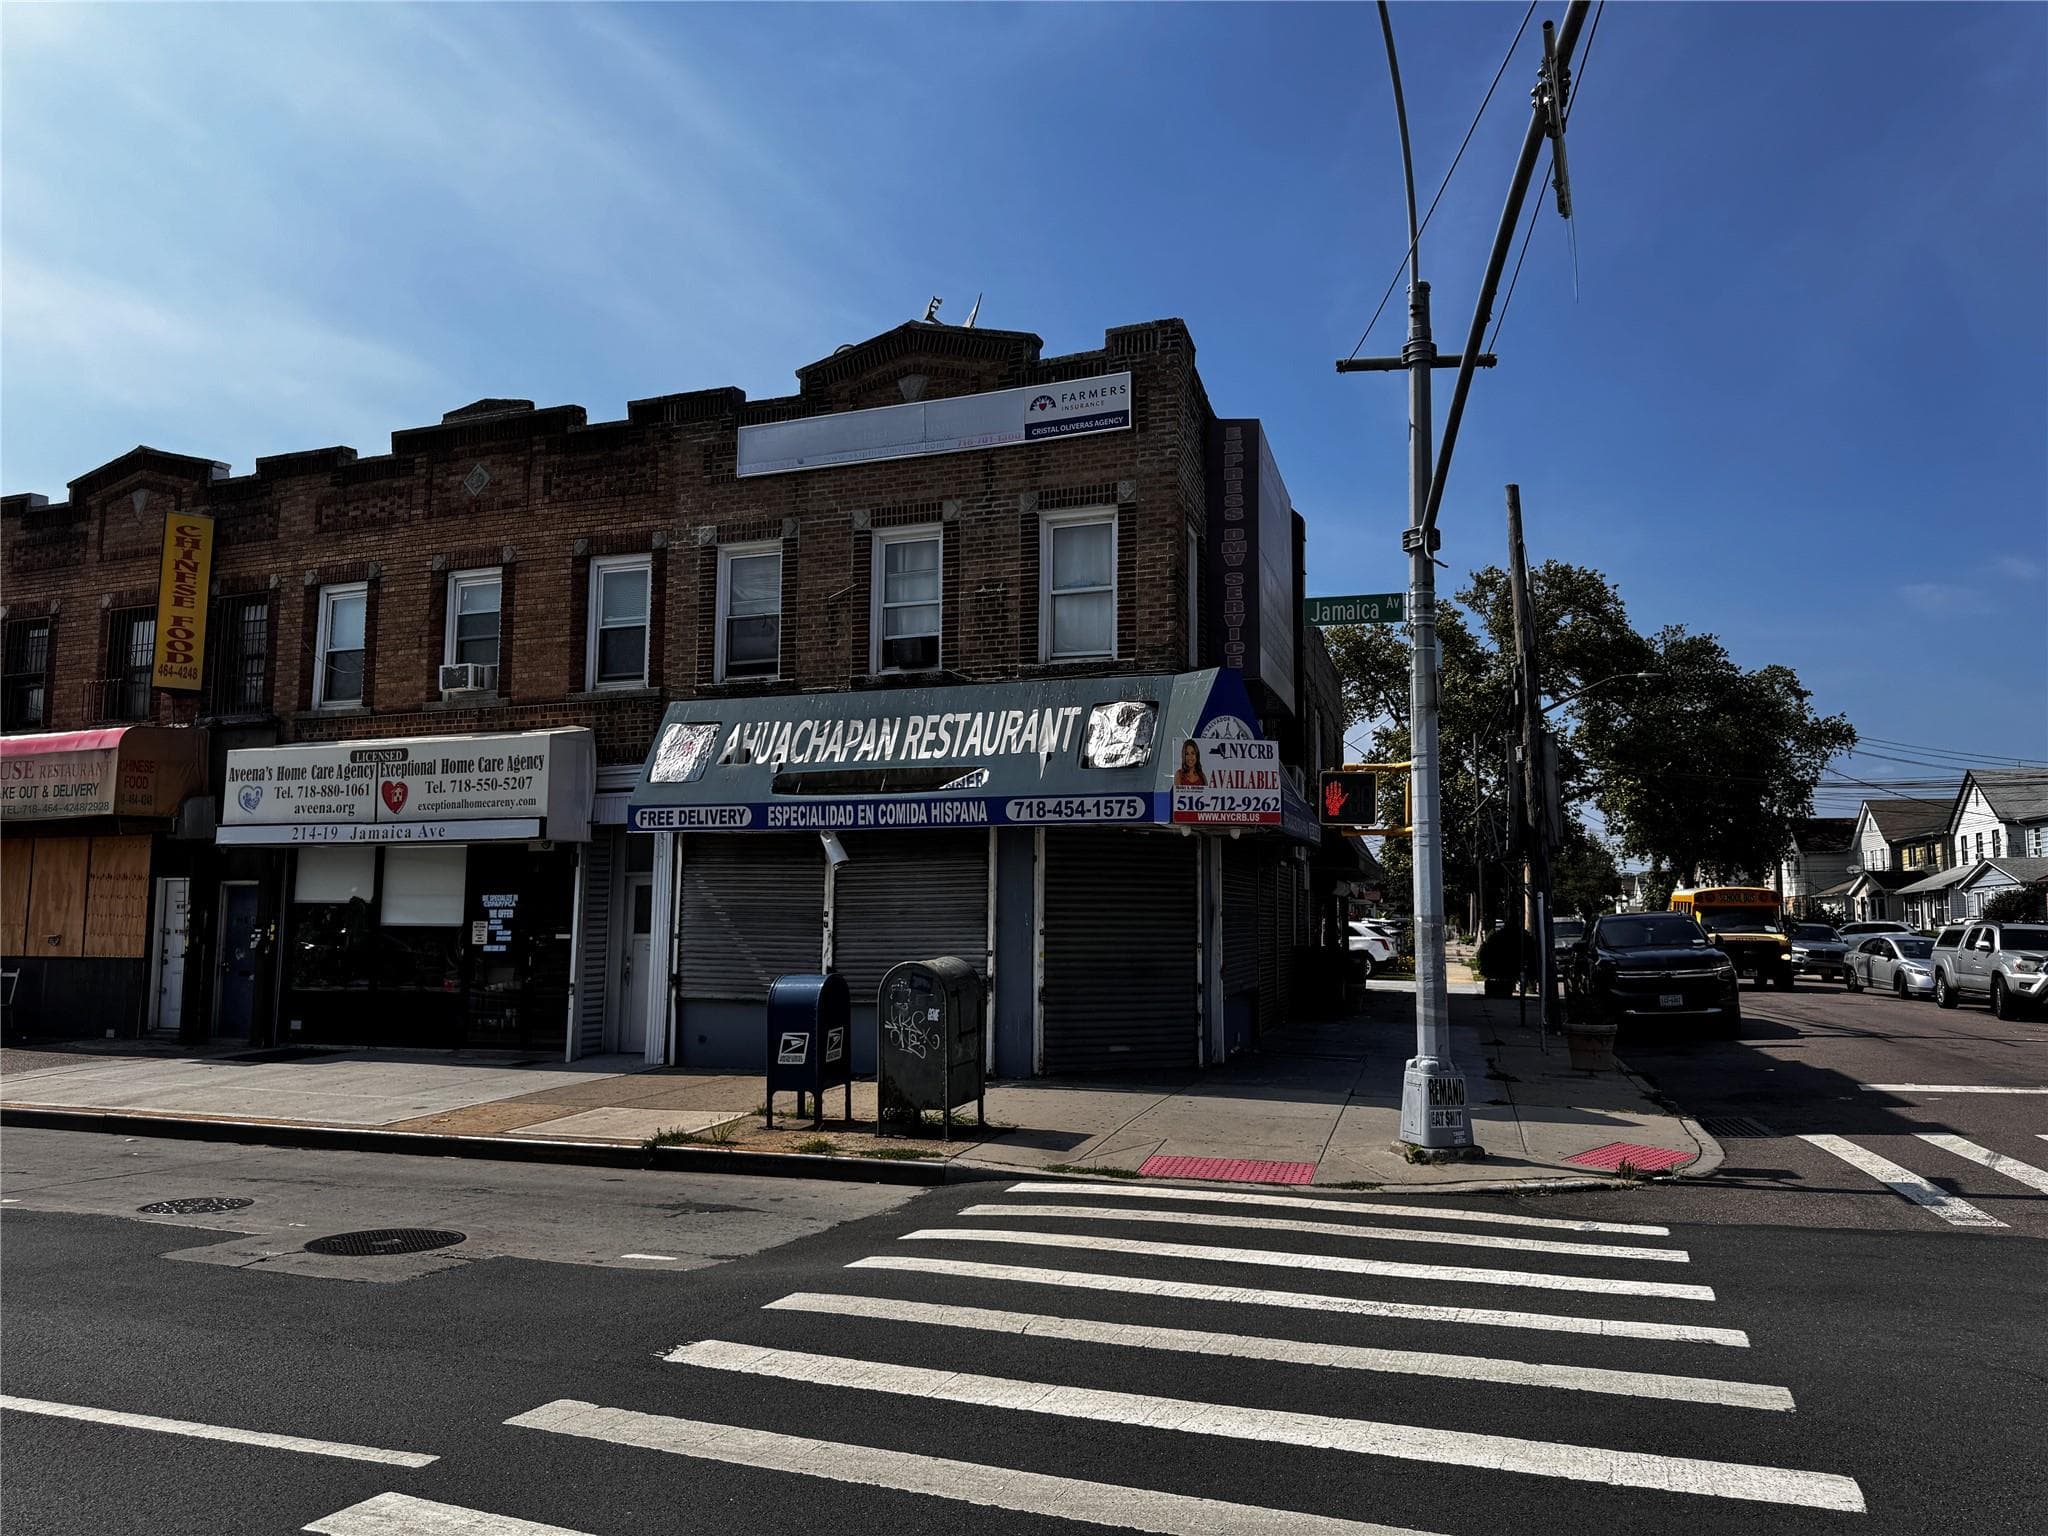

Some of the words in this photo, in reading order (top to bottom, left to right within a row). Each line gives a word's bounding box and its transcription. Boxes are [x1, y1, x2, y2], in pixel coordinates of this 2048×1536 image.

[1062, 384, 1126, 403] FARMERS
[1061, 400, 1105, 411] INSURANCE
[1031, 425, 1061, 435] CRISTAL
[1061, 421, 1093, 431] OLIVERAS
[1094, 416, 1124, 427] AGENCY
[1223, 425, 1245, 521] EXPRESS
[1221, 527, 1247, 567] DMV
[172, 525, 202, 609] CHINESE
[1310, 599, 1380, 622] Jamaica
[1386, 596, 1400, 609] Av
[1223, 571, 1246, 668] SERVICE
[166, 615, 195, 664] FOOD
[158, 664, 198, 680] 464-4248
[716, 718, 901, 766] AHUACHAPAN
[899, 706, 1082, 760] RESTAURANT
[356, 750, 403, 763] LICENSED
[1229, 743, 1274, 760] NYCRB
[39, 760, 112, 779] RESTAURANT
[119, 759, 155, 774] CHINESE
[228, 766, 273, 782] Aveena's
[277, 766, 307, 781] Home
[311, 764, 334, 780] Care
[336, 764, 376, 781] Agency
[380, 759, 436, 779] Exceptional
[441, 758, 475, 775] Home
[478, 756, 504, 773] Care
[507, 754, 545, 773] Agency
[124, 775, 149, 789] FOOD
[425, 780, 446, 794] Tel.
[450, 776, 533, 793] 718-550-5207
[1209, 769, 1279, 790] AVAILABLE
[0, 786, 16, 799] KE
[19, 785, 39, 799] OUT
[42, 785, 49, 798] &
[53, 782, 100, 798] DELIVERY
[274, 786, 294, 799] Tel.
[297, 783, 370, 798] 718-880-1061
[294, 803, 355, 816] aveena.org
[417, 797, 536, 813] exceptionalhomecareny.com
[1013, 799, 1138, 819] 718-454-1575
[1177, 795, 1280, 812] 516-712-9262
[639, 810, 674, 826] FREE
[678, 808, 747, 825] DELIVERY
[768, 804, 853, 827] ESPECIALIDAD
[858, 803, 875, 825] EN
[878, 801, 928, 824] COMIDA
[930, 800, 988, 823] HISPANA
[1197, 812, 1260, 822] WWW.NYCRB.US
[291, 826, 338, 840] 214-19
[349, 825, 412, 840] Jamaica
[417, 824, 446, 838] Ave
